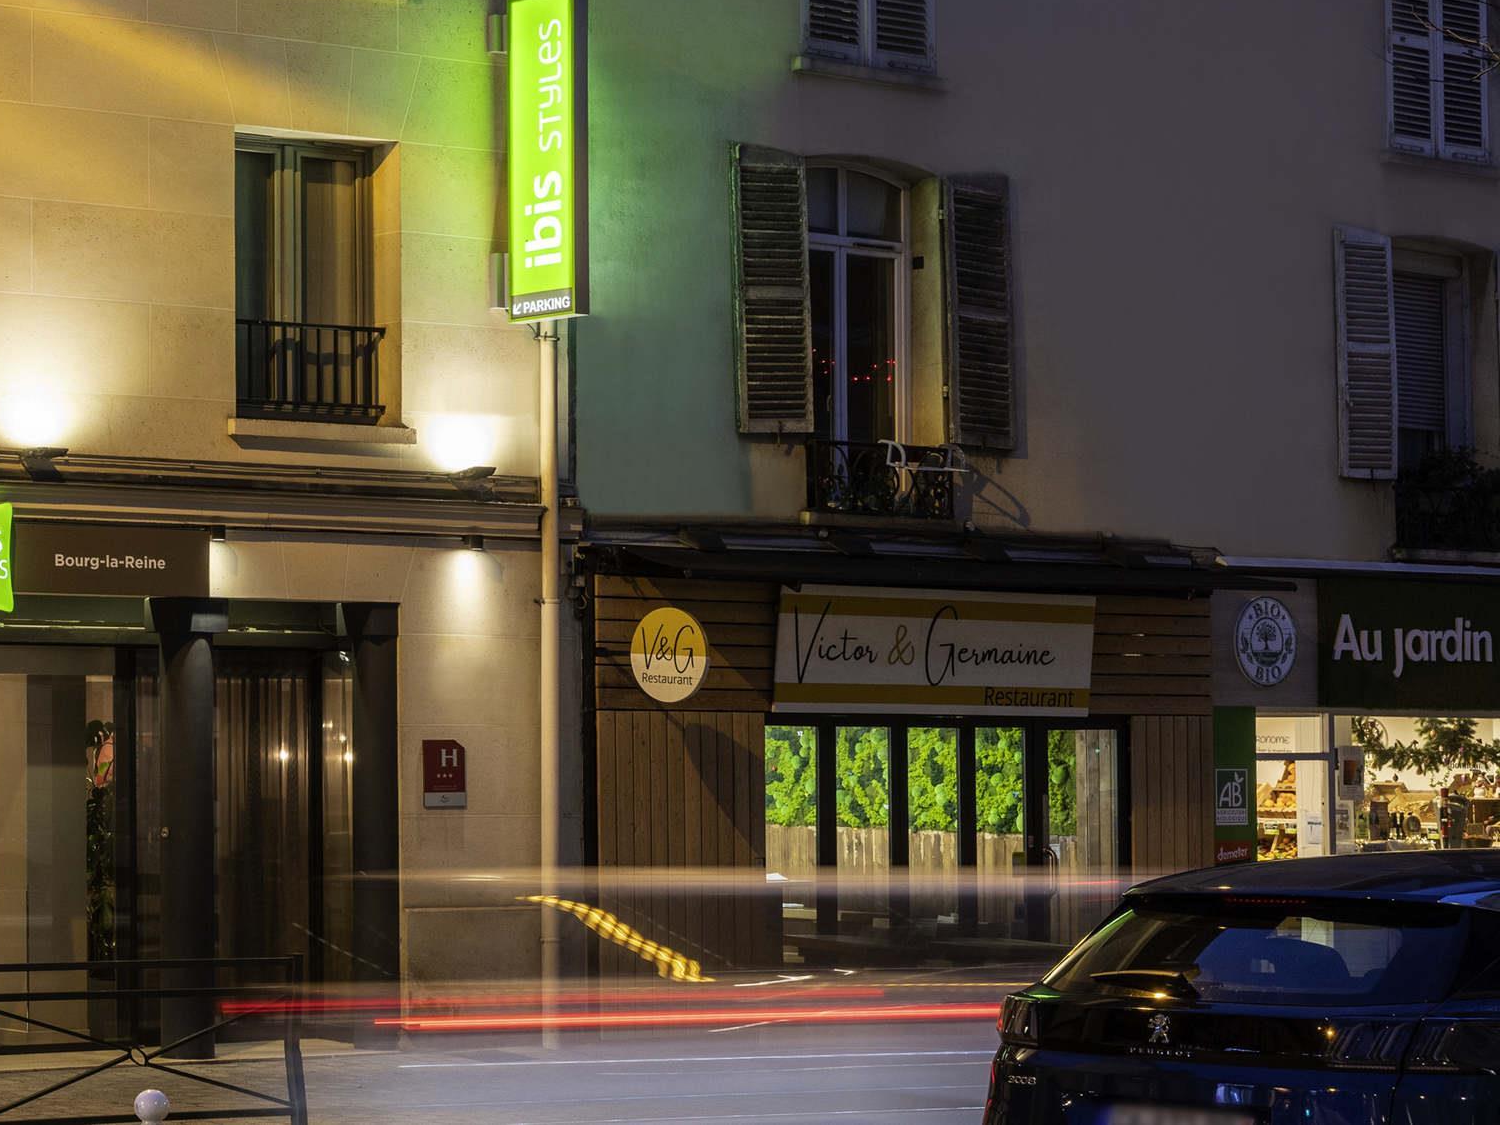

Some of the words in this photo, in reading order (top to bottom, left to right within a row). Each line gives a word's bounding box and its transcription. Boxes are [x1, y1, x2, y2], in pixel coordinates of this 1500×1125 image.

[525, 171, 562, 268] ibis
[523, 296, 571, 314] PARKING
[54, 553, 166, 570] Bourg-la-Reine
[1252, 600, 1281, 619] BIO
[794, 601, 879, 684] Victor
[887, 624, 915, 666] &
[925, 605, 1056, 687] Germaine
[1334, 614, 1382, 661] Au
[642, 672, 692, 687] Restaurant
[1255, 665, 1282, 682] BIO
[984, 686, 1075, 708] Restaurant
[441, 748, 458, 767] H
[1219, 781, 1243, 807] AB
[1216, 846, 1248, 861] demeter
